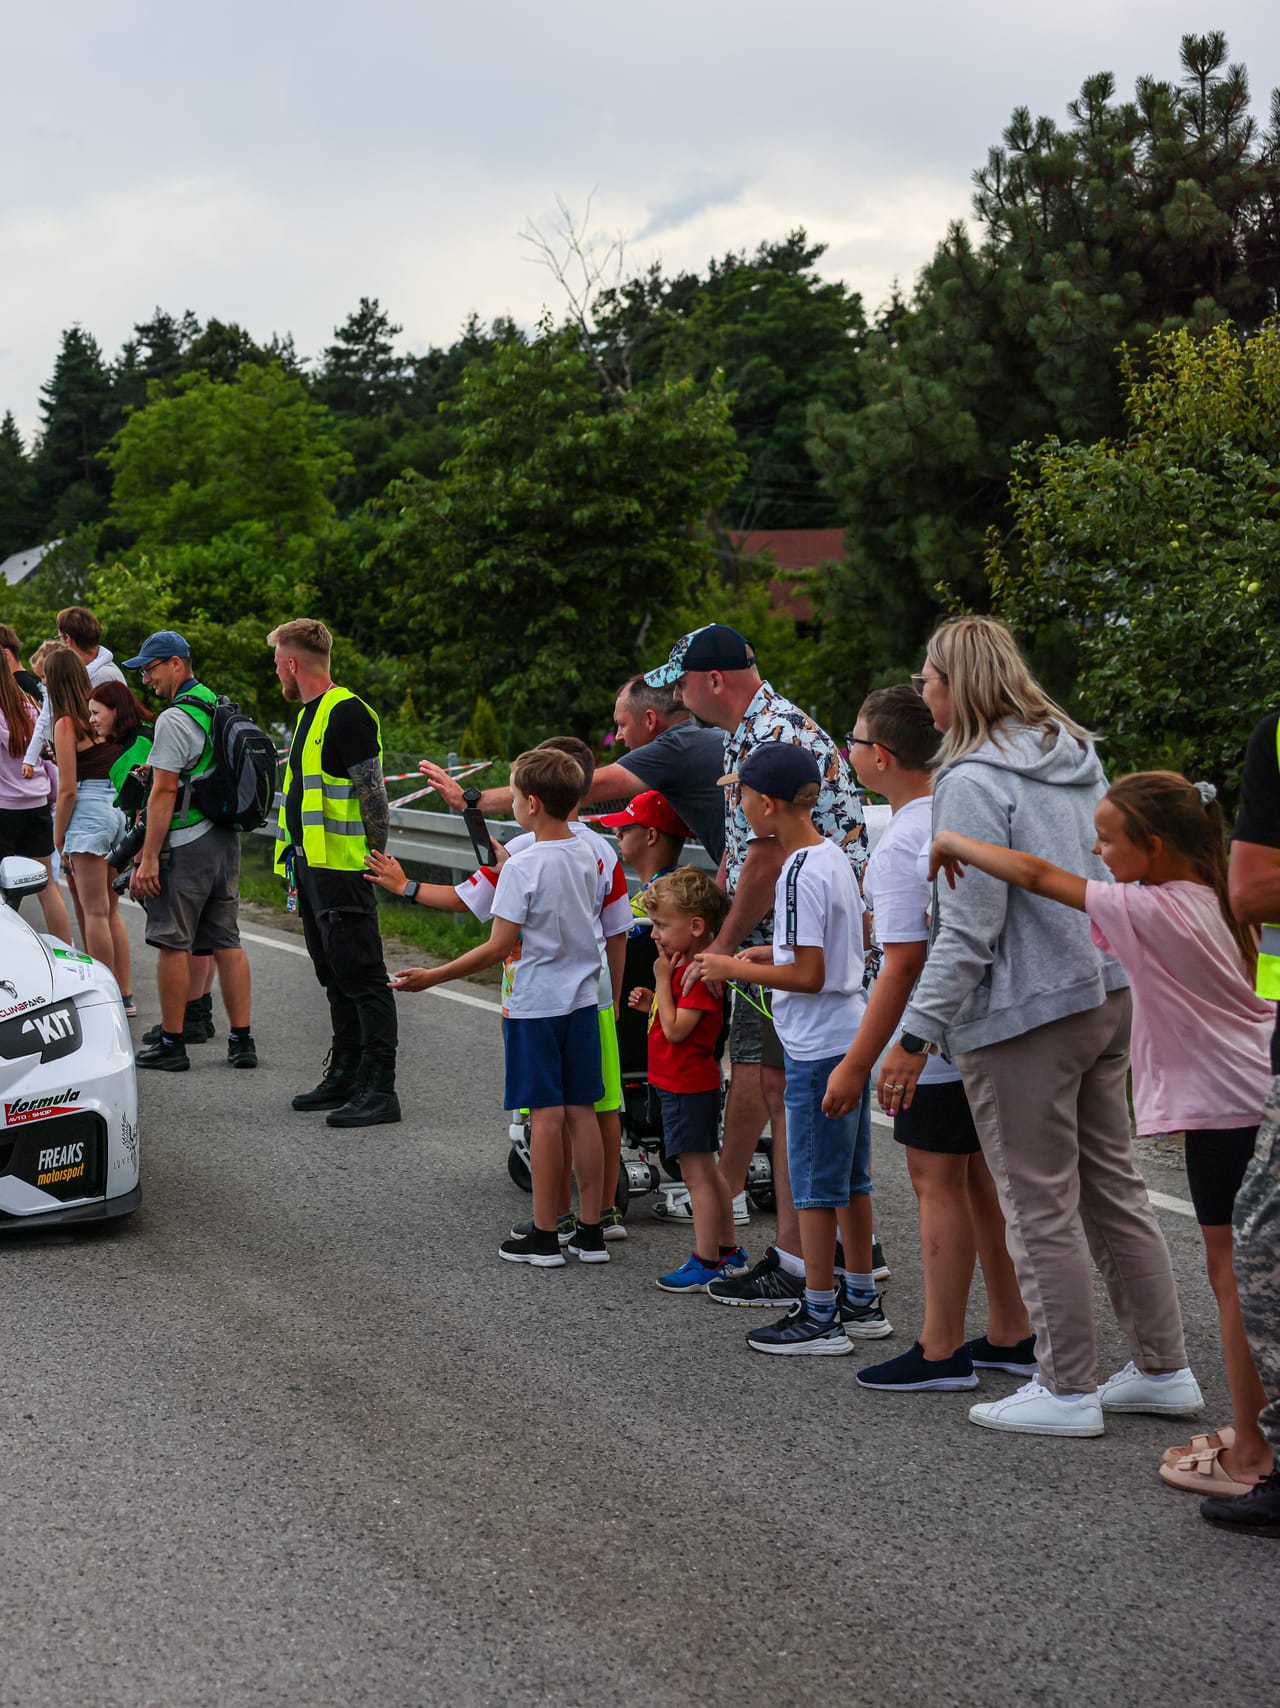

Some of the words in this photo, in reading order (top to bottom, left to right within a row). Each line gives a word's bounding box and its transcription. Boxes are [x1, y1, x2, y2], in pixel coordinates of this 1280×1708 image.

[33, 1009, 75, 1044] KIT
[8, 1088, 80, 1115] formula
[32, 1109, 52, 1118] SHOP
[38, 1142, 84, 1171] FREAKS
[37, 1163, 85, 1186] motorsport
